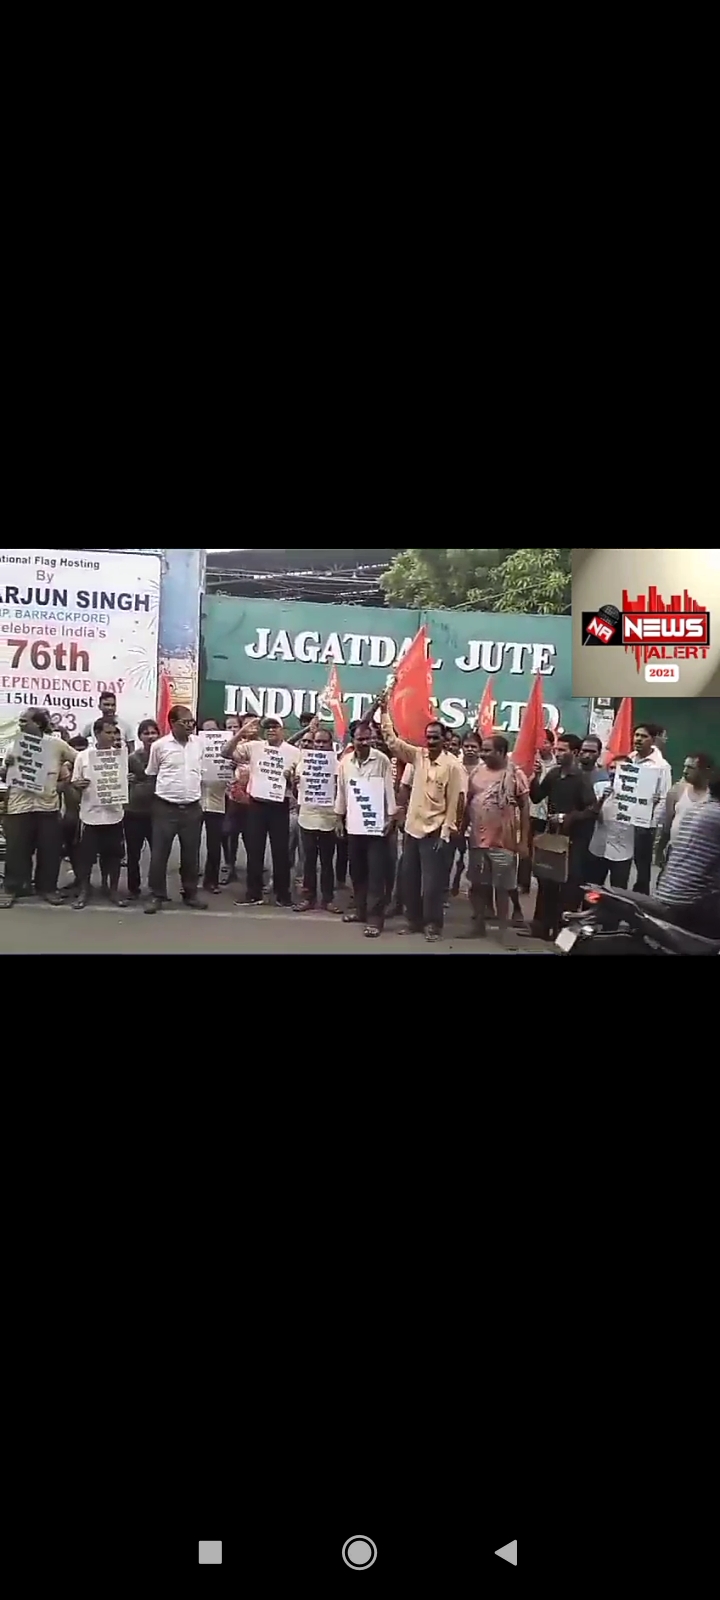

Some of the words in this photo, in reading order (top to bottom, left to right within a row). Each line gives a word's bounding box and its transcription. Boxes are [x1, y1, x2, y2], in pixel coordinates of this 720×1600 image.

[0, 555, 31, 564] tional
[34, 556, 56, 568] Flag
[60, 558, 100, 570] Hosting
[36, 570, 54, 583] By
[76, 591, 150, 612] SINGH
[15, 610, 110, 625] BARRACKPORE)
[62, 626, 106, 638] India's
[7, 639, 89, 672] 76th
[455, 640, 556, 675] JUTE
[97, 681, 125, 694] DAY
[6, 692, 38, 705] 15th
[43, 694, 94, 710] August
